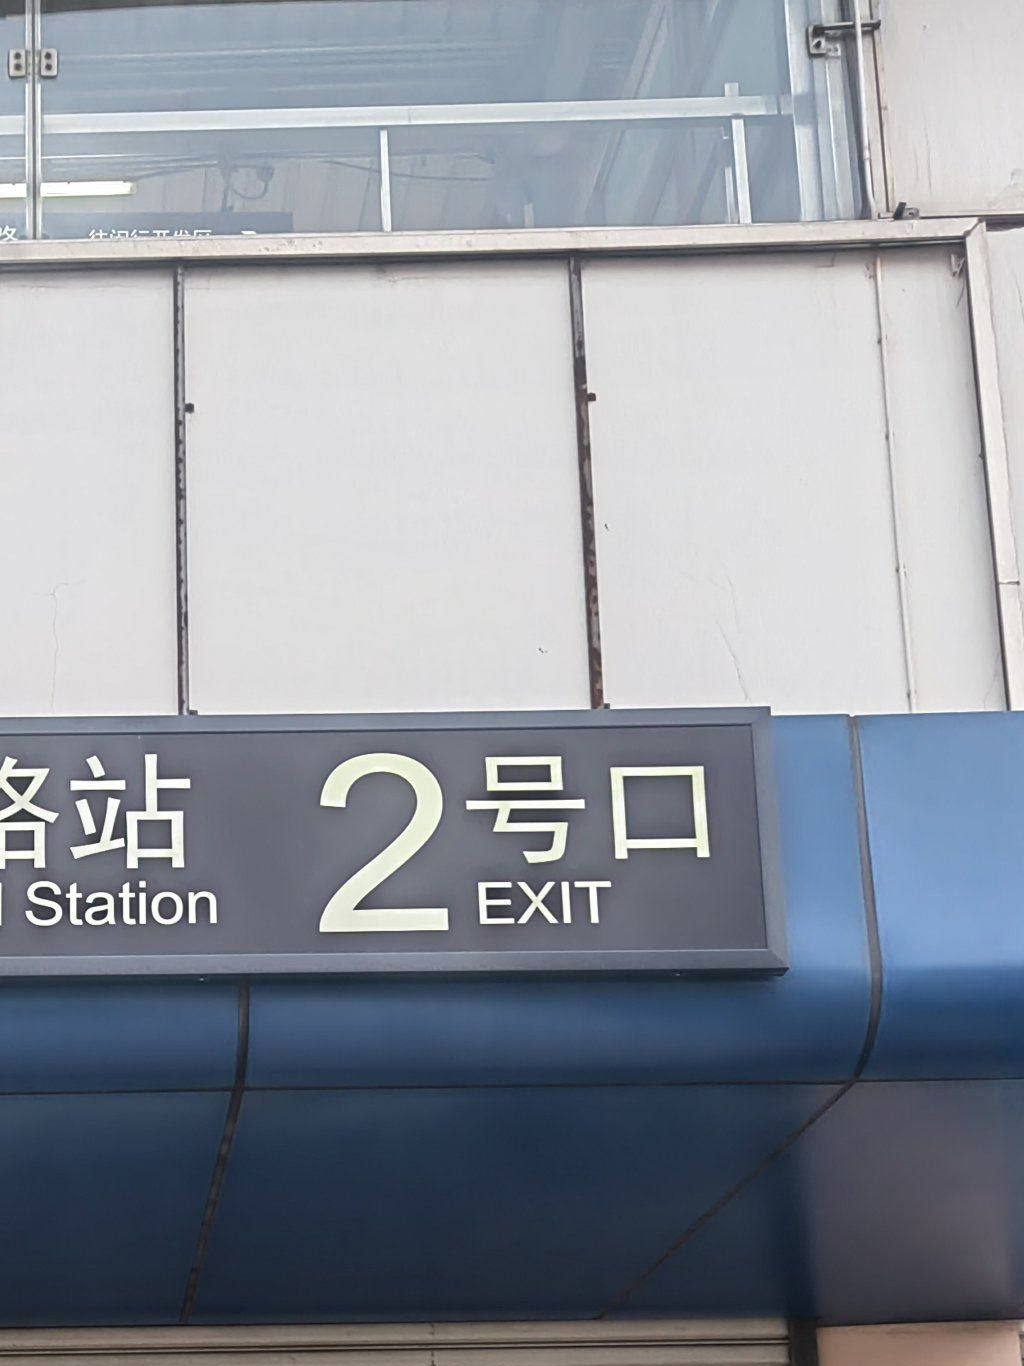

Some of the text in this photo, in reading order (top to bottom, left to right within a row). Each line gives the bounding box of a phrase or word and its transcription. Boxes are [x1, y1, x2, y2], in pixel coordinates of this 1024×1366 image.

[319, 752, 711, 933] 2 号口
[24, 880, 218, 927] Station
[477, 880, 612, 925] EXIT
